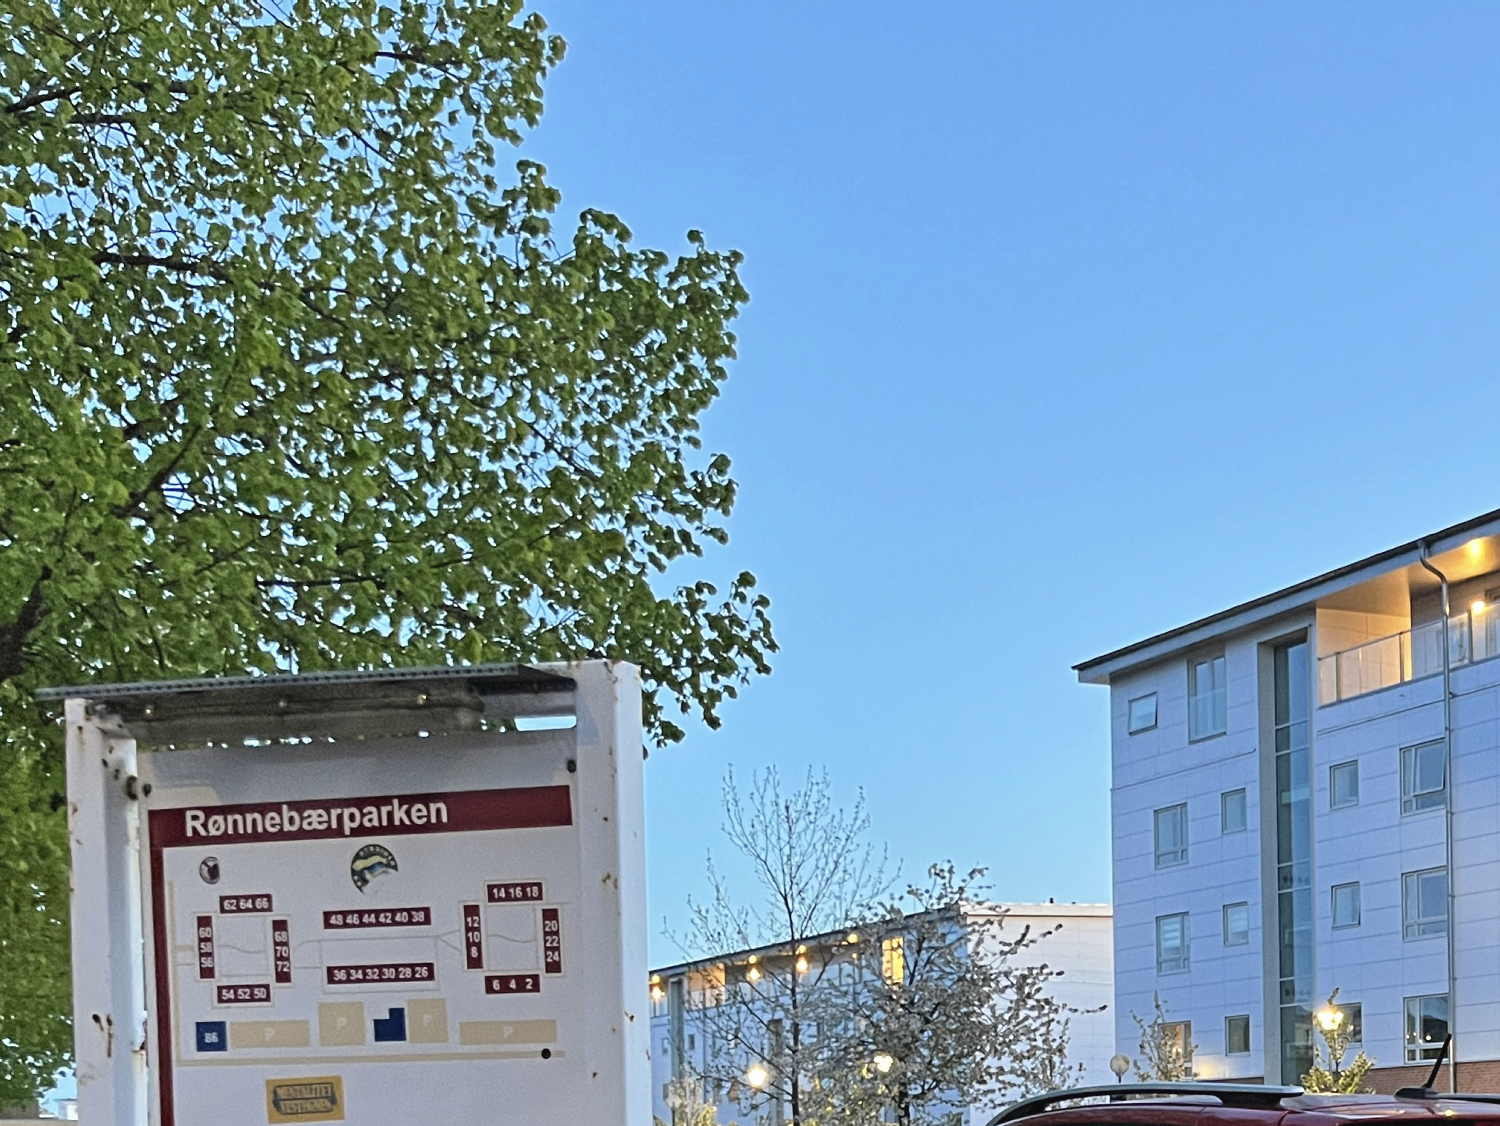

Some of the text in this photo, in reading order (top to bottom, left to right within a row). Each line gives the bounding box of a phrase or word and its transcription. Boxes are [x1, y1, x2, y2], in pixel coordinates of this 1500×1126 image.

[185, 799, 448, 837] Rønnebærparken
[493, 886, 539, 899] 14 16 18
[223, 898, 269, 910] 62 64 66
[329, 911, 424, 926] 48 46 44 42 40 38
[466, 916, 479, 927] 12
[544, 920, 558, 931] 20
[199, 928, 212, 938] 60
[274, 931, 288, 942] 68
[467, 931, 480, 942] 10
[545, 936, 559, 947] 22
[200, 943, 213, 953] 58
[275, 947, 289, 957] 70
[471, 946, 478, 958] 8
[200, 957, 214, 967] 56
[546, 951, 560, 962] 24
[276, 962, 290, 972] 72
[333, 967, 428, 981] 36 34 32 30 28 26
[493, 978, 533, 990] 6 4 2
[222, 988, 266, 1000] 54 52 50
[504, 1026, 514, 1039] P
